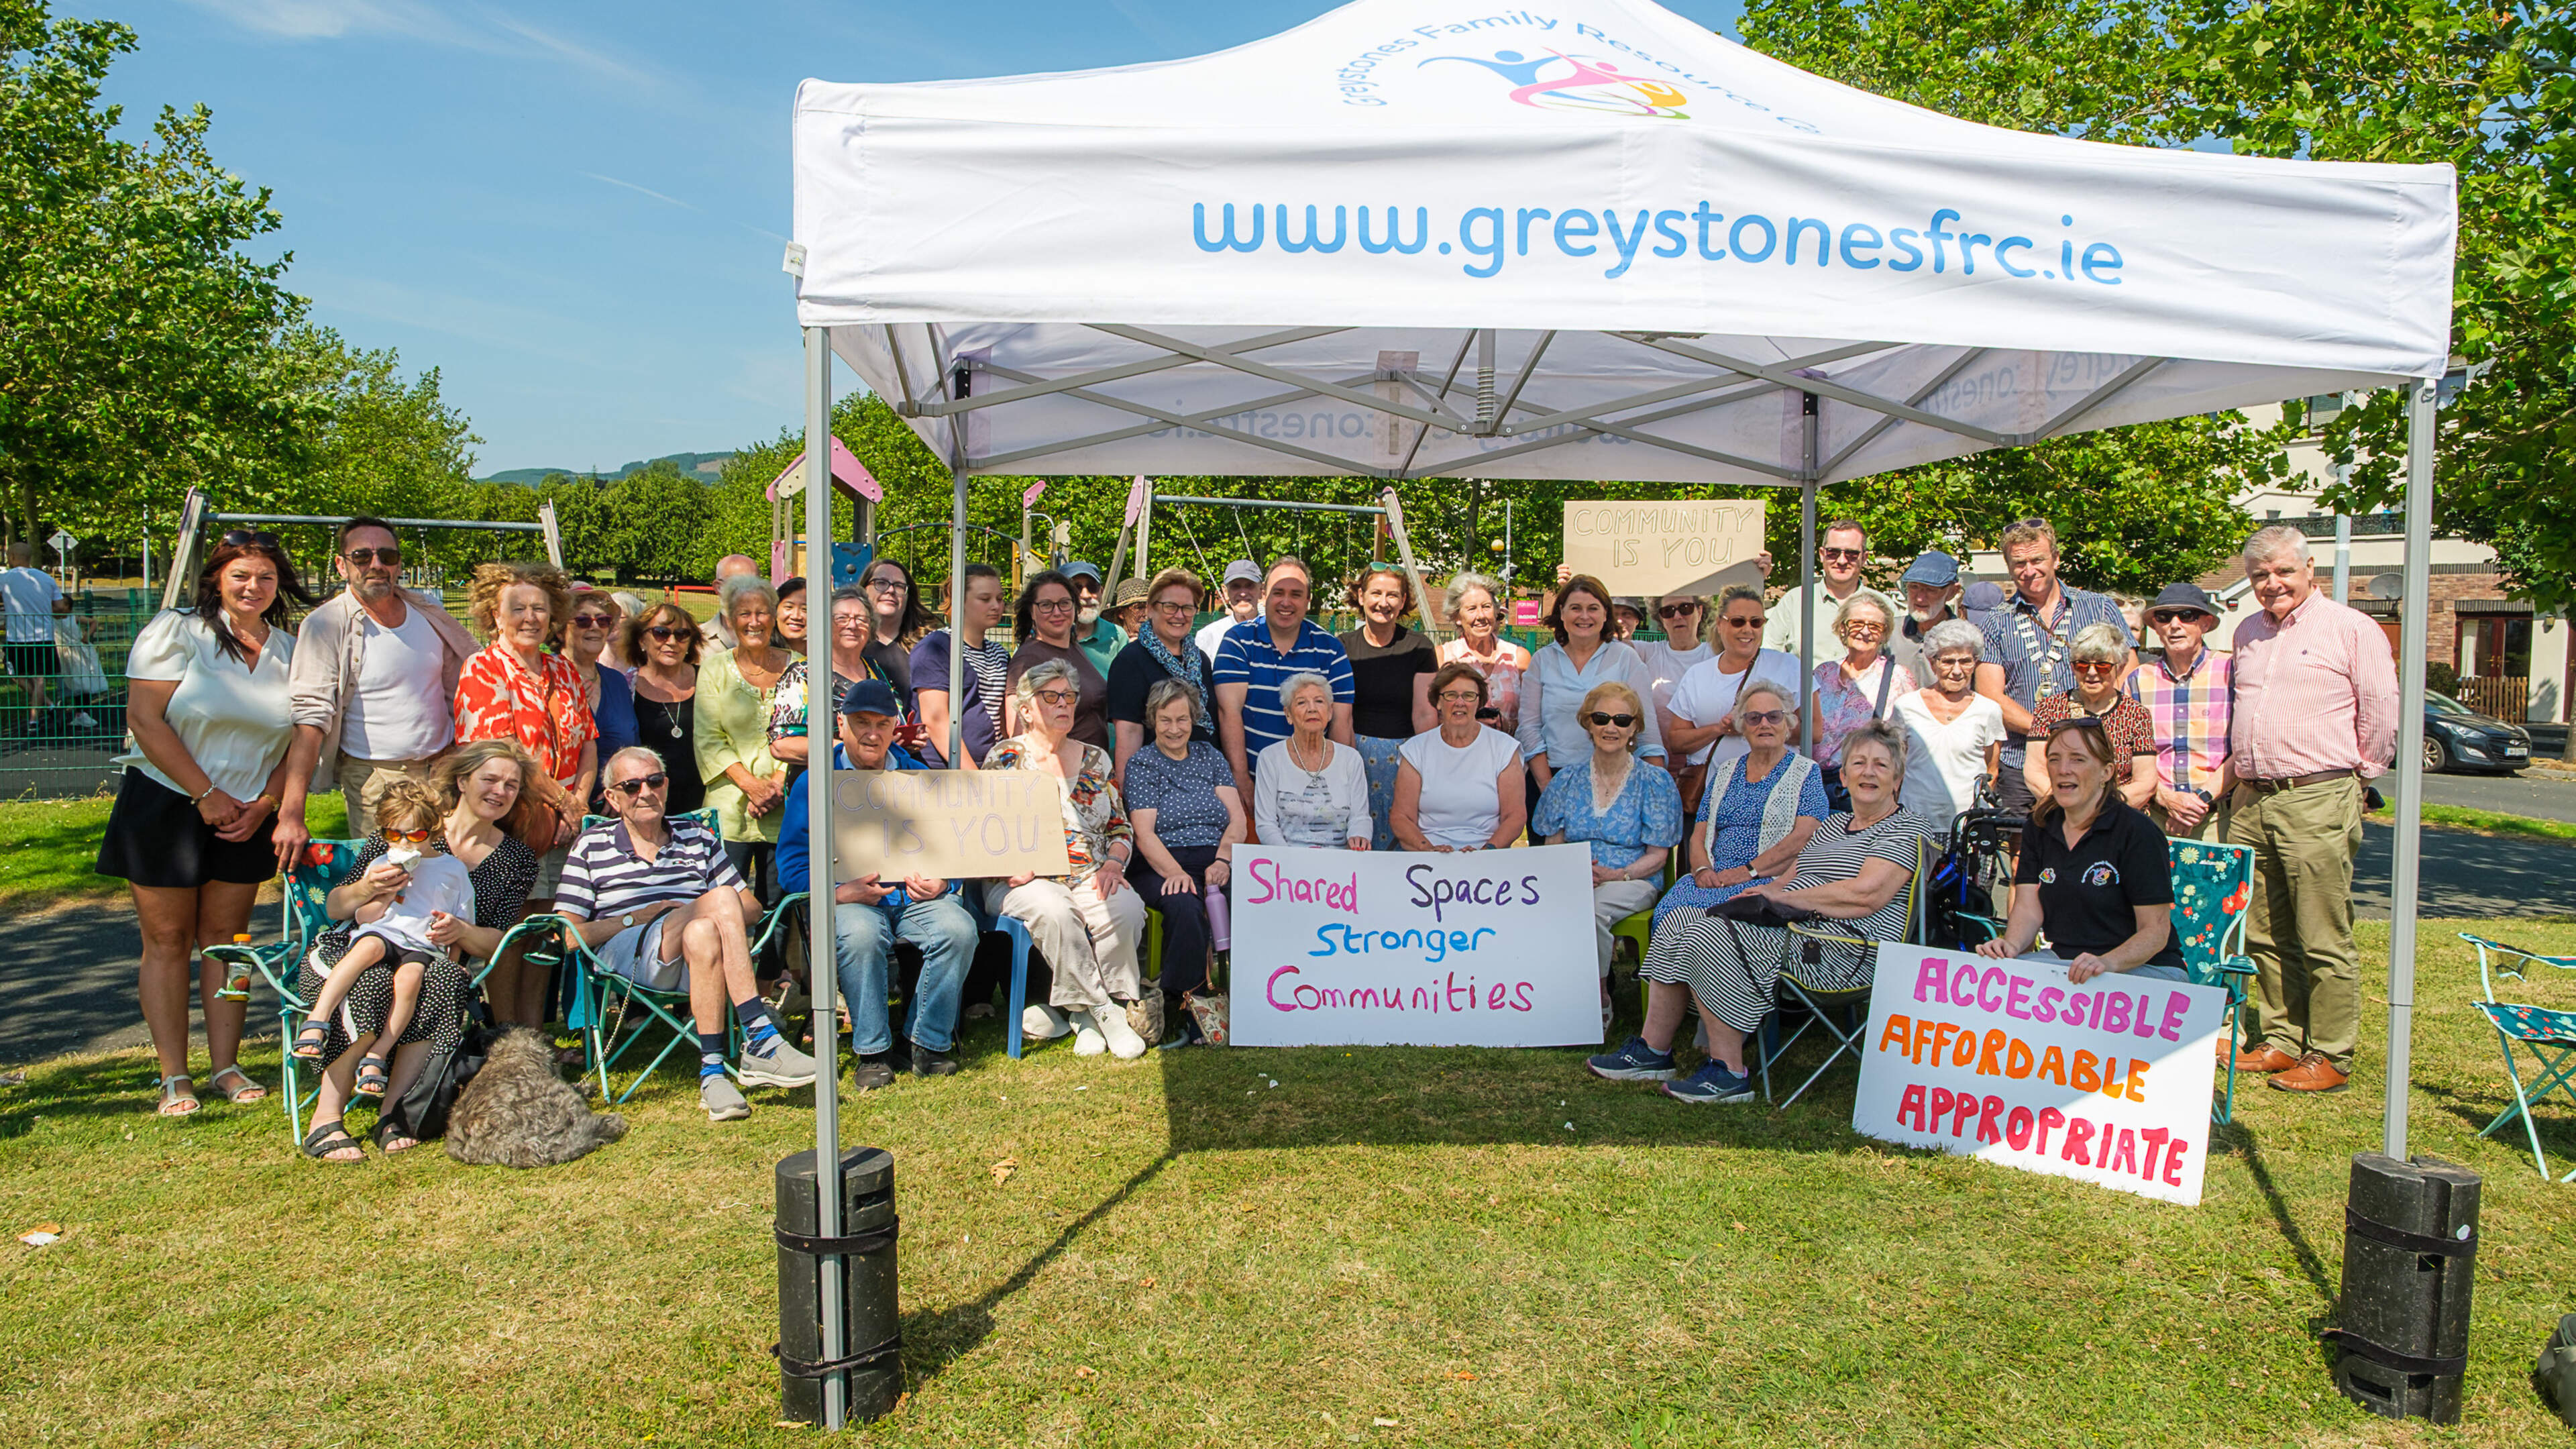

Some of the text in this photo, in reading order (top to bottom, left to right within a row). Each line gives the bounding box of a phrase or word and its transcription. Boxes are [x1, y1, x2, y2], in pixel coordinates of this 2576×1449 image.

[1336, 38, 1419, 107] Greystones
[1412, 10, 1558, 40] Family
[1576, 23, 1771, 112] Resource
[1191, 199, 2125, 286] www.greystonesfrc.ie
[1573, 507, 1754, 536] COMMUNITY
[1613, 537, 1733, 568] IS YOU
[837, 776, 1040, 811] COMMUNITY
[882, 813, 1040, 857] IS YOU
[1247, 858, 1541, 923] Shared Spaces
[1307, 922, 1497, 963] Stronger
[1266, 965, 1535, 1014] Communities
[1913, 957, 2191, 1042] ACCESSIBLE
[1878, 1013, 2151, 1103] AFFORDABLE
[1896, 1083, 2189, 1187] APPROPRIATE
